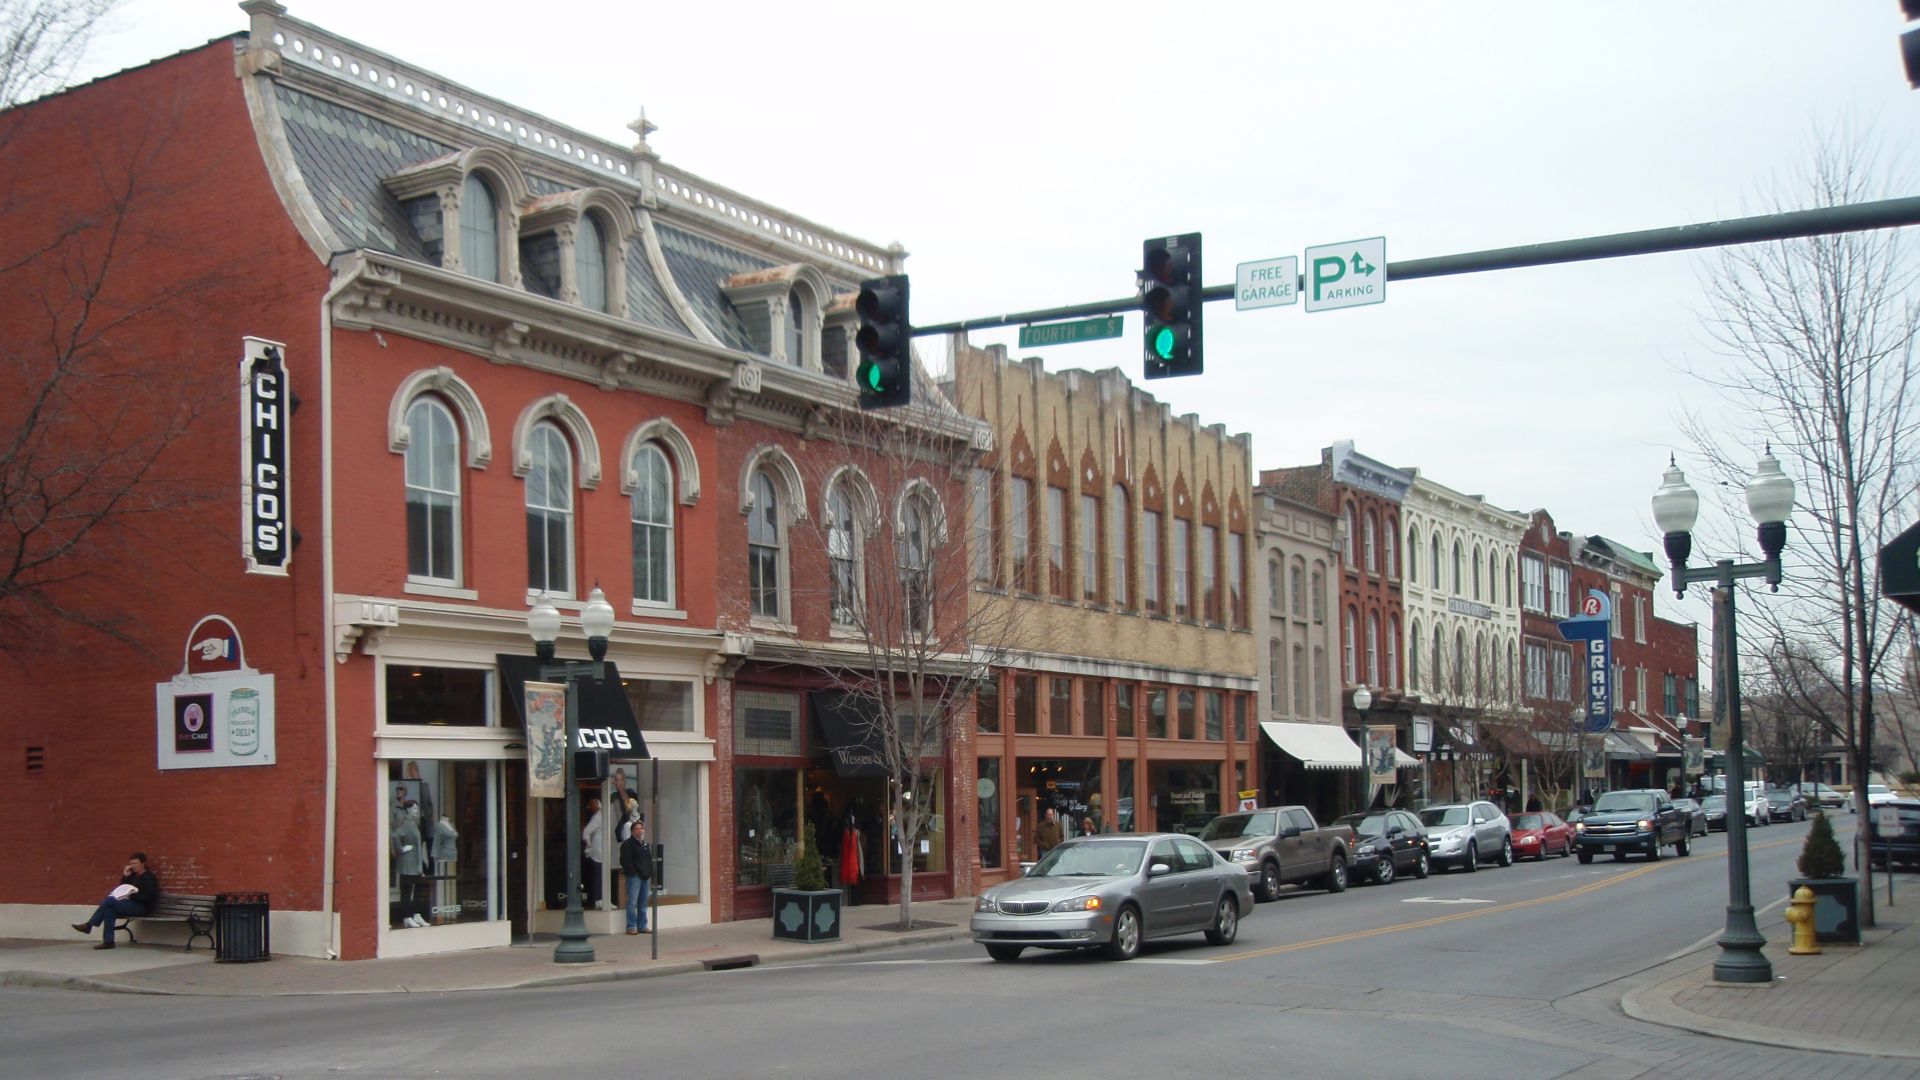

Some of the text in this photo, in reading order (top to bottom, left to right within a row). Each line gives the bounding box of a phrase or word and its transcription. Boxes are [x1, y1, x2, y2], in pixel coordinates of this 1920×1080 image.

[1251, 266, 1282, 282] FREE
[1241, 283, 1292, 302] GARAGE
[1024, 325, 1076, 345] FOURTH
[1106, 319, 1115, 335] S
[256, 372, 283, 551] CHICO'S
[1590, 639, 1607, 715] GRAY'S
[235, 728, 251, 737] DELI
